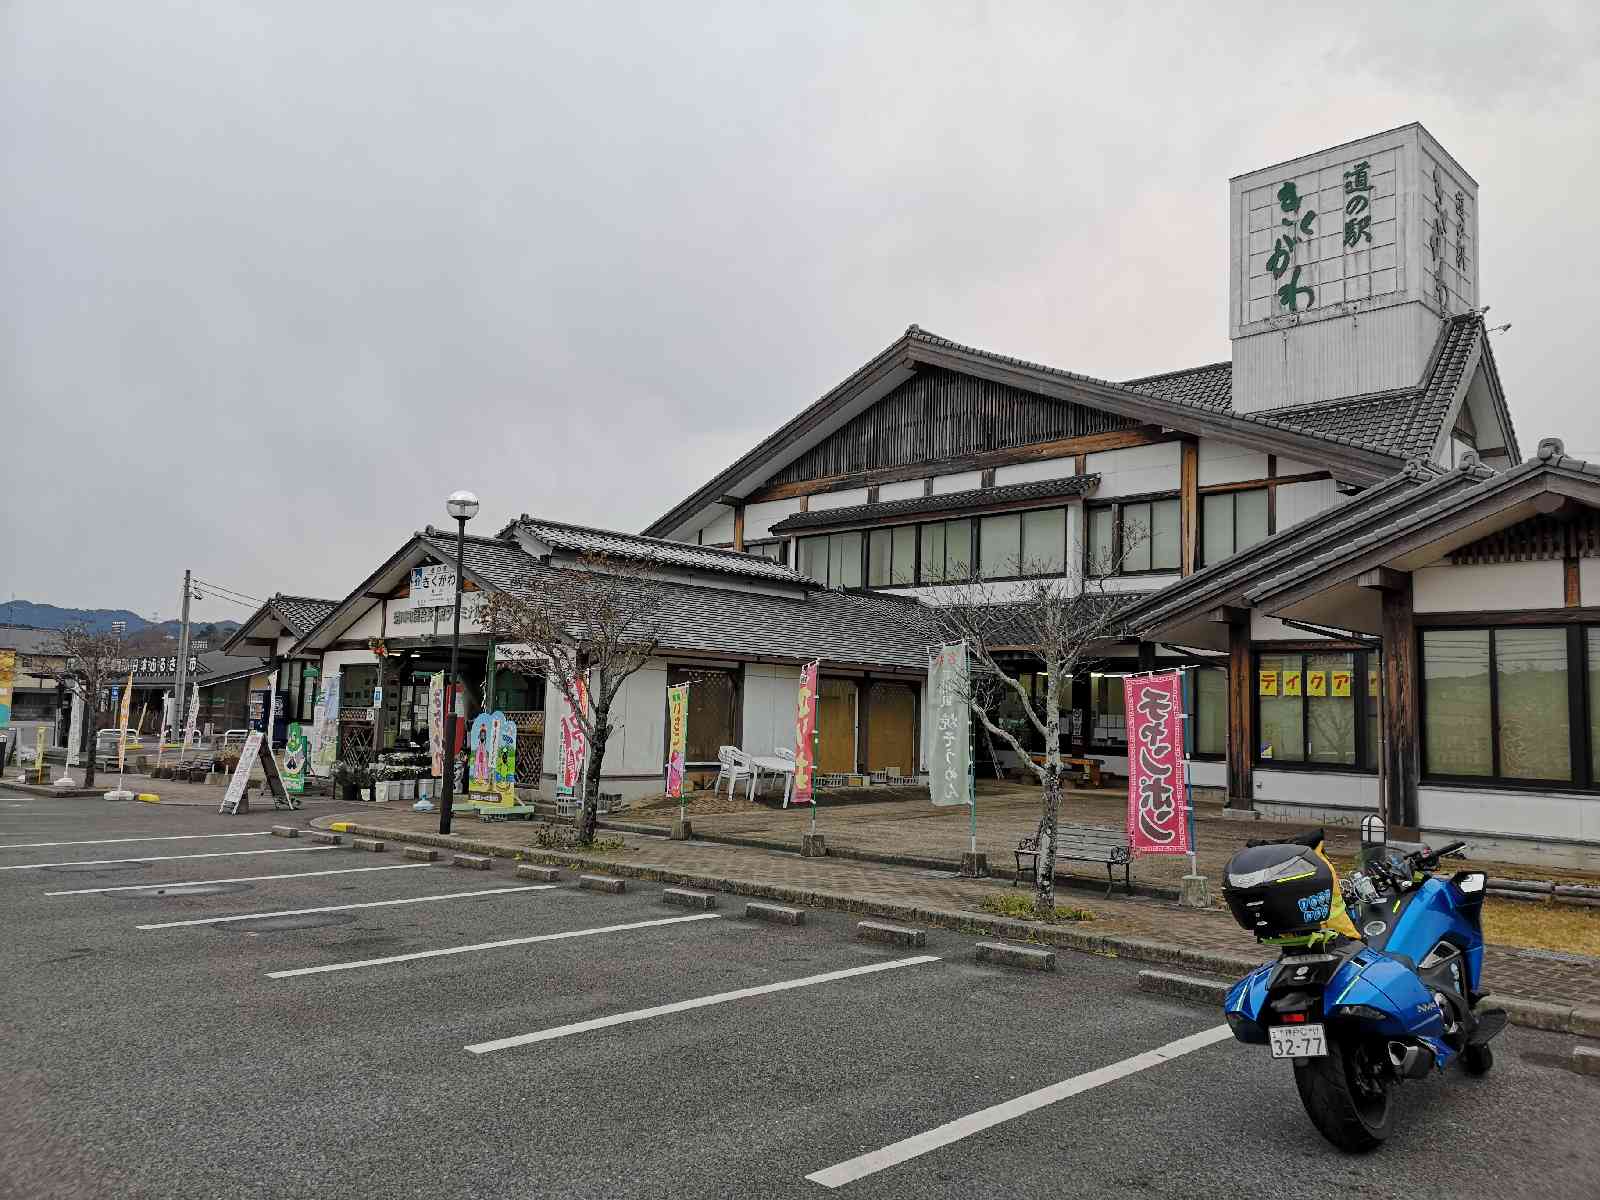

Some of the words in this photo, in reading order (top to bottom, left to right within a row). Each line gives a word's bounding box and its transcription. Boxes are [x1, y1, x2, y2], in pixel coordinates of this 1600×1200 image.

[1343, 161, 1374, 247] 道の駅
[1266, 181, 1315, 311] きくがわ
[423, 574, 456, 588] きくがわ
[1274, 1037, 1322, 1056] 32-77
